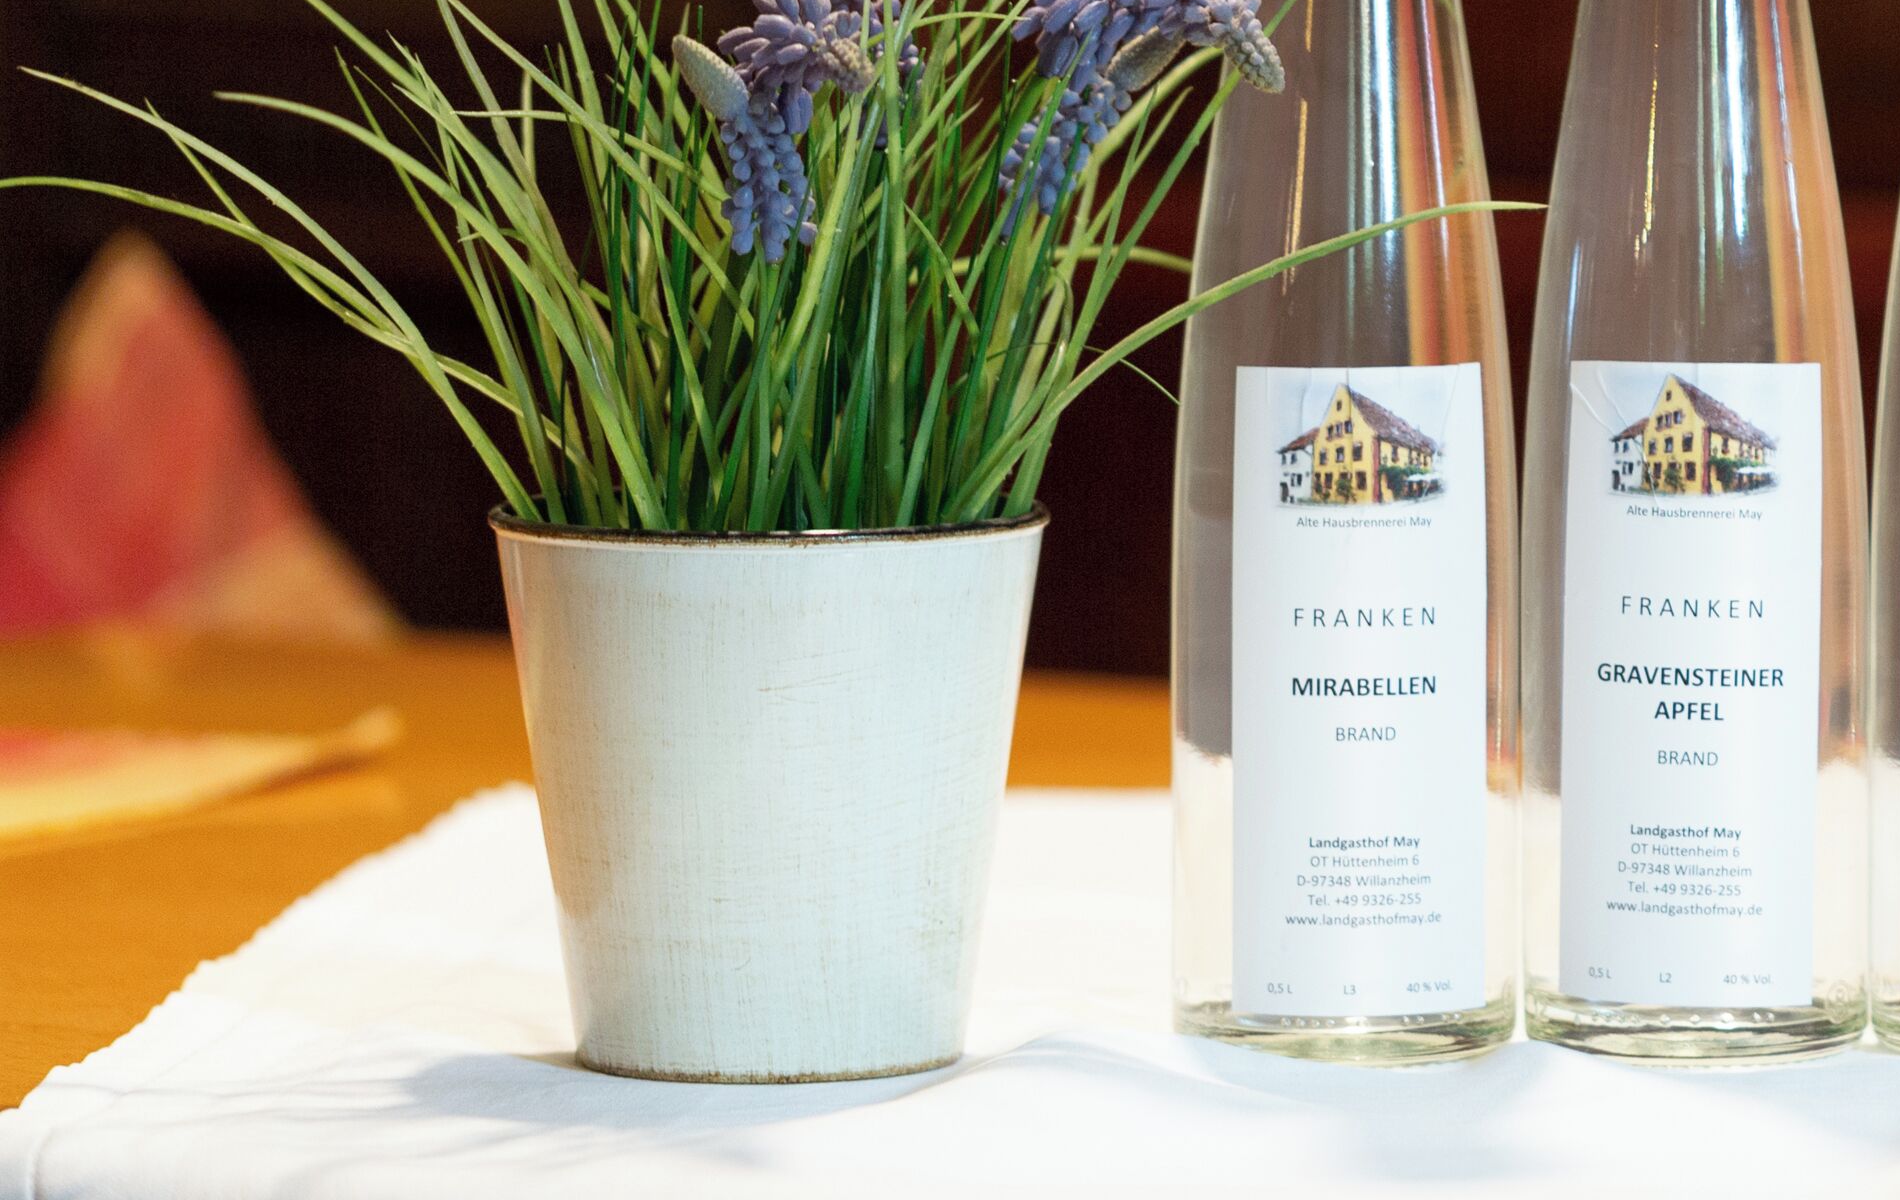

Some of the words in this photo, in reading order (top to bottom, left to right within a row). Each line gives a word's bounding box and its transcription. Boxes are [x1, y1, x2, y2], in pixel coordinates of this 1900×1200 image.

[1626, 504, 1649, 517] Alte
[1651, 506, 1736, 520] Hausbrennerei
[1738, 508, 1763, 521] May
[1296, 516, 1320, 528] Alte
[1322, 517, 1408, 529] Hausbrennerei
[1409, 516, 1432, 527] May
[1621, 595, 1763, 619] FRANKEN
[1294, 606, 1435, 628] FRANKEN
[1597, 662, 1784, 687] GRAVENSTEINER
[1292, 675, 1436, 697] MIRABELLEN
[1654, 700, 1724, 721] APFEL
[1335, 726, 1397, 742] BRAND
[1657, 749, 1719, 767] BRAND
[1630, 823, 1709, 840] Landgasthof
[1713, 827, 1742, 841] May
[1308, 836, 1389, 852] Landgasthof
[1393, 835, 1421, 849] May
[1630, 842, 1649, 855] OT
[1651, 843, 1729, 858] Hüttenheim
[1732, 846, 1741, 859] 6
[1309, 855, 1329, 868] OT
[1332, 855, 1409, 868] Hüttenheim
[1411, 853, 1420, 866] 6
[1617, 860, 1671, 876] D-97348
[1673, 863, 1753, 878] Willanzheim
[1296, 874, 1352, 888] D-97348
[1355, 873, 1432, 888] Willanzheim
[1627, 880, 1649, 894] Tel.
[1653, 882, 1677, 896] +49
[1679, 883, 1742, 897] 9326-255
[1307, 893, 1330, 907] Tel.
[1334, 894, 1359, 907] +49
[1361, 892, 1422, 907] 9326-255
[1606, 900, 1763, 918] www.landgasthofmay.de
[1284, 911, 1442, 929] www.landgasthofmay.de
[1588, 965, 1604, 980] 0,5
[1658, 972, 1673, 984] L2
[1722, 973, 1738, 985] 40
[1739, 973, 1751, 985] %
[1266, 981, 1284, 995] 0,5
[1343, 984, 1357, 996] L3
[1405, 981, 1421, 994] 40
[1422, 981, 1433, 993] %
